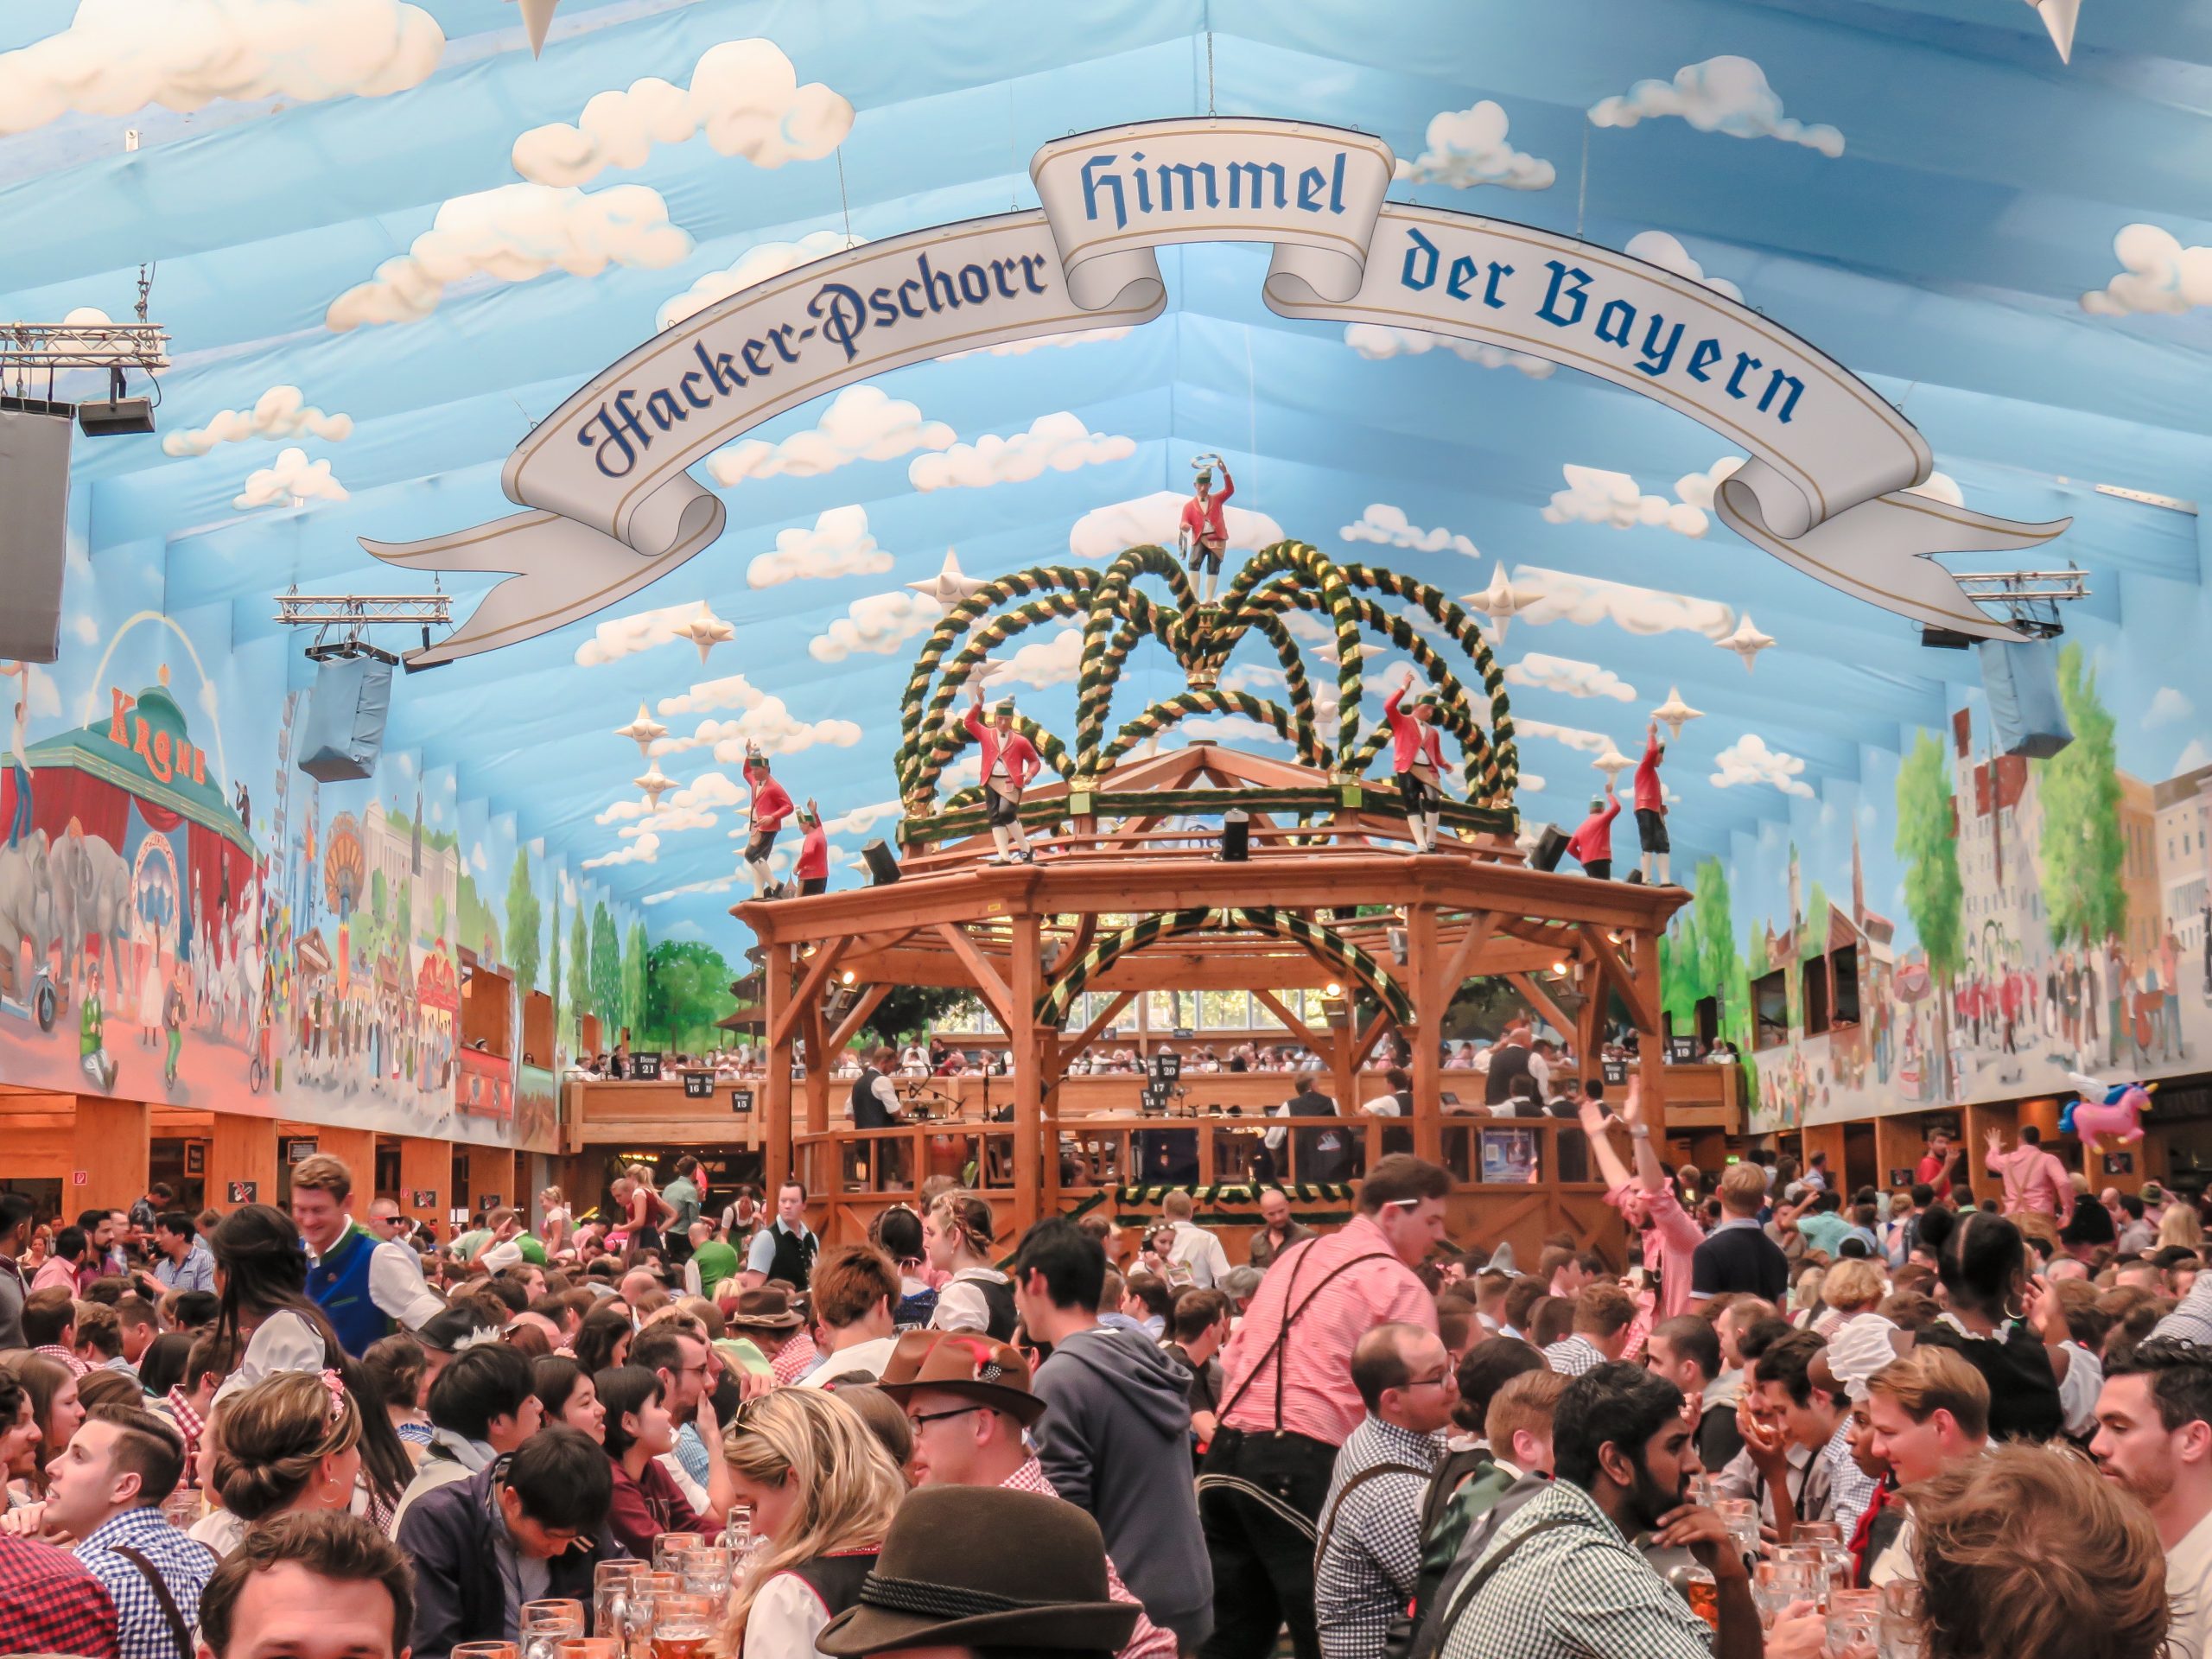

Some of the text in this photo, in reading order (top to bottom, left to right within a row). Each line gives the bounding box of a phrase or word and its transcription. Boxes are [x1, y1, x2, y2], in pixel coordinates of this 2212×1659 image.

[1080, 151, 1347, 231] Himmel
[1401, 227, 1806, 424] der Bayern
[577, 251, 1048, 479] Hacker-Pschorr
[108, 686, 207, 785] KRONE
[642, 1064, 655, 1074] 21
[1163, 1066, 1176, 1076] 20
[689, 1084, 700, 1093] 16
[1154, 1083, 1165, 1092] 17
[737, 1100, 747, 1109] 15
